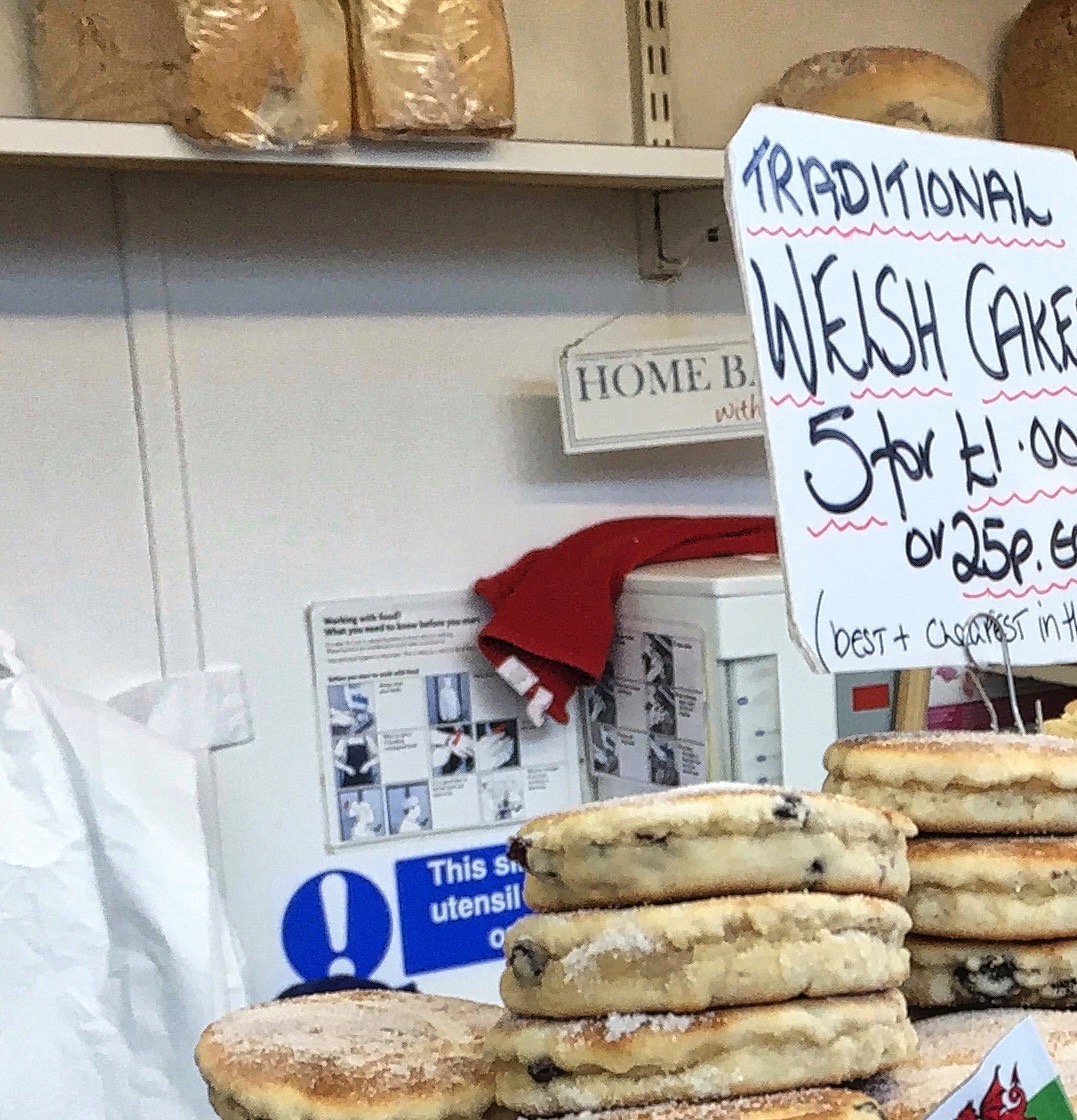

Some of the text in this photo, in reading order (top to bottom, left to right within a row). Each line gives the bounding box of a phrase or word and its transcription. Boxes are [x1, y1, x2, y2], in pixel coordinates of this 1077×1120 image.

[743, 135, 1053, 228] TRADITIONAL
[750, 244, 948, 396] WELSH
[576, 357, 712, 402] HOME
[715, 394, 761, 423] with
[805, 406, 873, 513] 5
[870, 410, 934, 519] for
[905, 527, 943, 567] or
[1037, 600, 1060, 642] in
[427, 857, 488, 887] This
[430, 882, 521, 924] utensil
